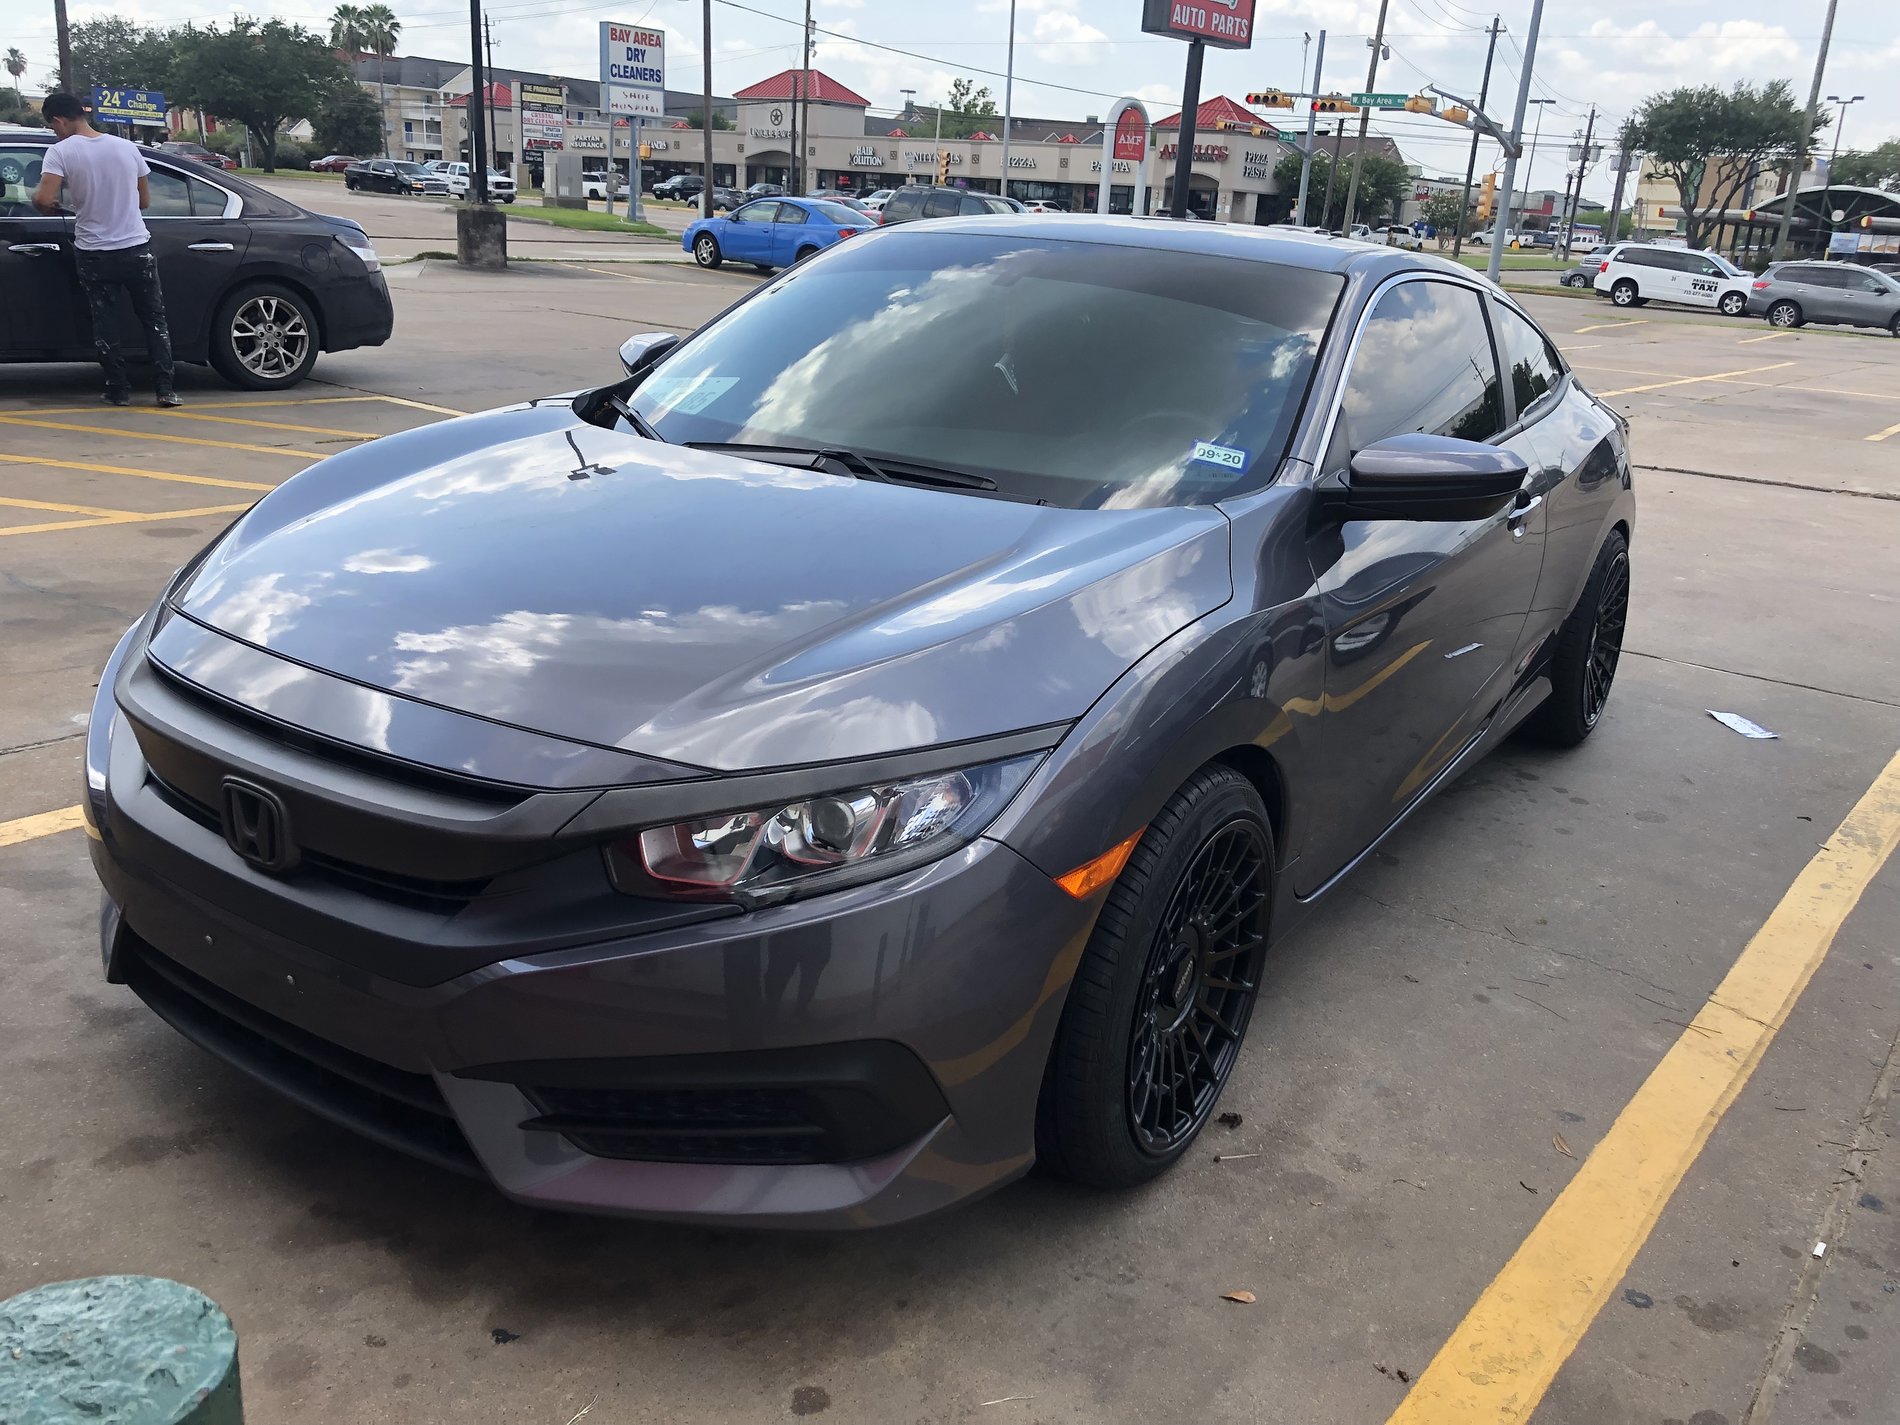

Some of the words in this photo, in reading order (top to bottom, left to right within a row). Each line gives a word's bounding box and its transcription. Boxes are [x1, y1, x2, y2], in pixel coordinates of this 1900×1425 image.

[1173, 4, 1206, 29] AUTO
[1211, 12, 1249, 38] PARTS
[610, 27, 631, 43] BAY
[633, 31, 662, 48] AREA
[626, 46, 646, 63] DRY
[610, 63, 662, 83] CLEANERS
[136, 93, 147, 102] Oil
[1362, 96, 1375, 105] Bay
[127, 99, 157, 111] Change
[572, 135, 601, 143] SPARTAN
[1118, 134, 1143, 145] AMF
[567, 141, 605, 150] INSURANCE
[856, 146, 874, 155] HAIR
[1245, 150, 1269, 165] PIZZA
[1692, 283, 1718, 292] TAXI
